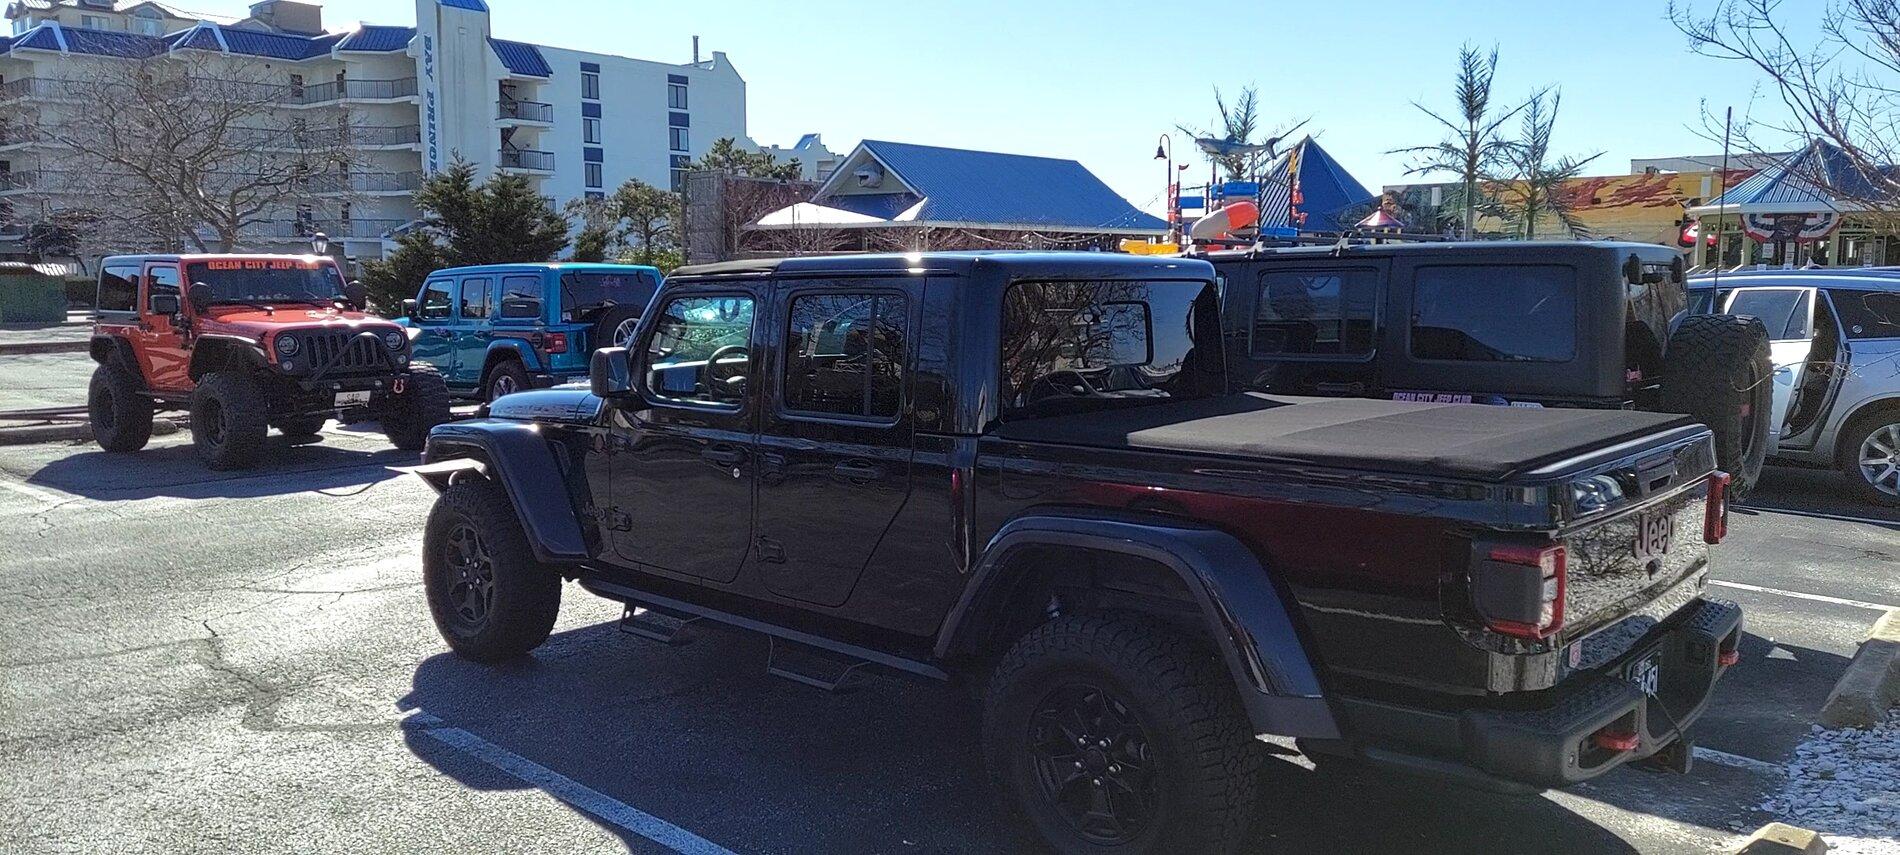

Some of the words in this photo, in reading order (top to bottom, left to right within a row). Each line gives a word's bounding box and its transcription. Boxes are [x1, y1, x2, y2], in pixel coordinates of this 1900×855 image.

[424, 34, 433, 82] BAY
[208, 261, 241, 270] OCEAN
[245, 261, 267, 270] CITY
[270, 261, 292, 270] JEEP
[1632, 512, 1674, 559] Jeep
